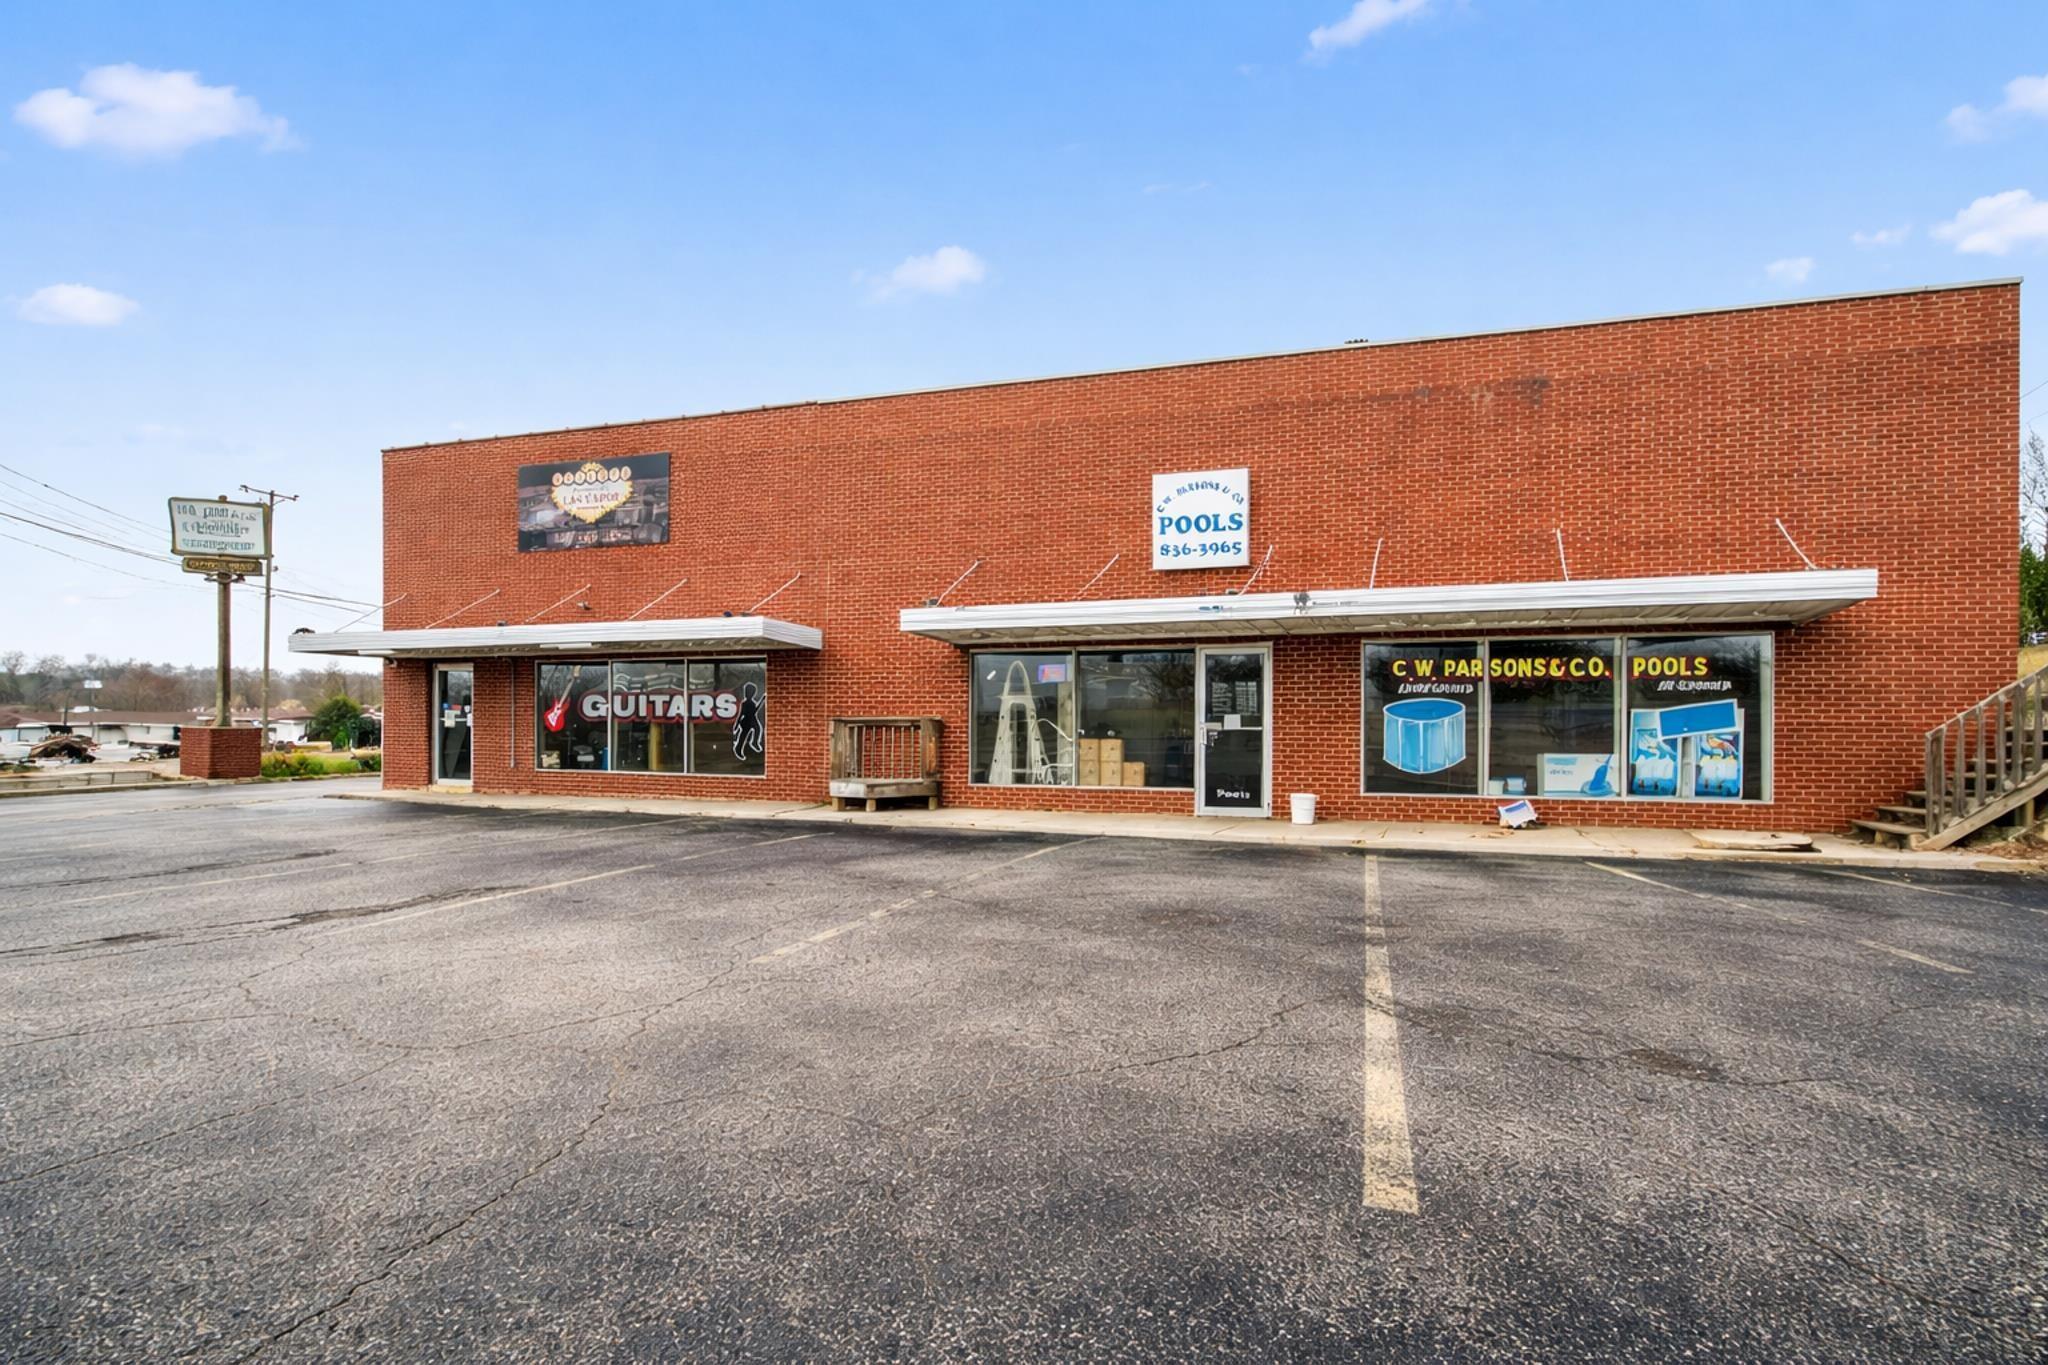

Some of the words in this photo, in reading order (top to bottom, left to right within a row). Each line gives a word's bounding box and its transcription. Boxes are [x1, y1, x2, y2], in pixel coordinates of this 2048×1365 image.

[1158, 512, 1244, 535] POOLS
[1160, 541, 1243, 558] 836-3965
[1632, 656, 1708, 677] POOLS
[581, 692, 738, 719] GUITARS
